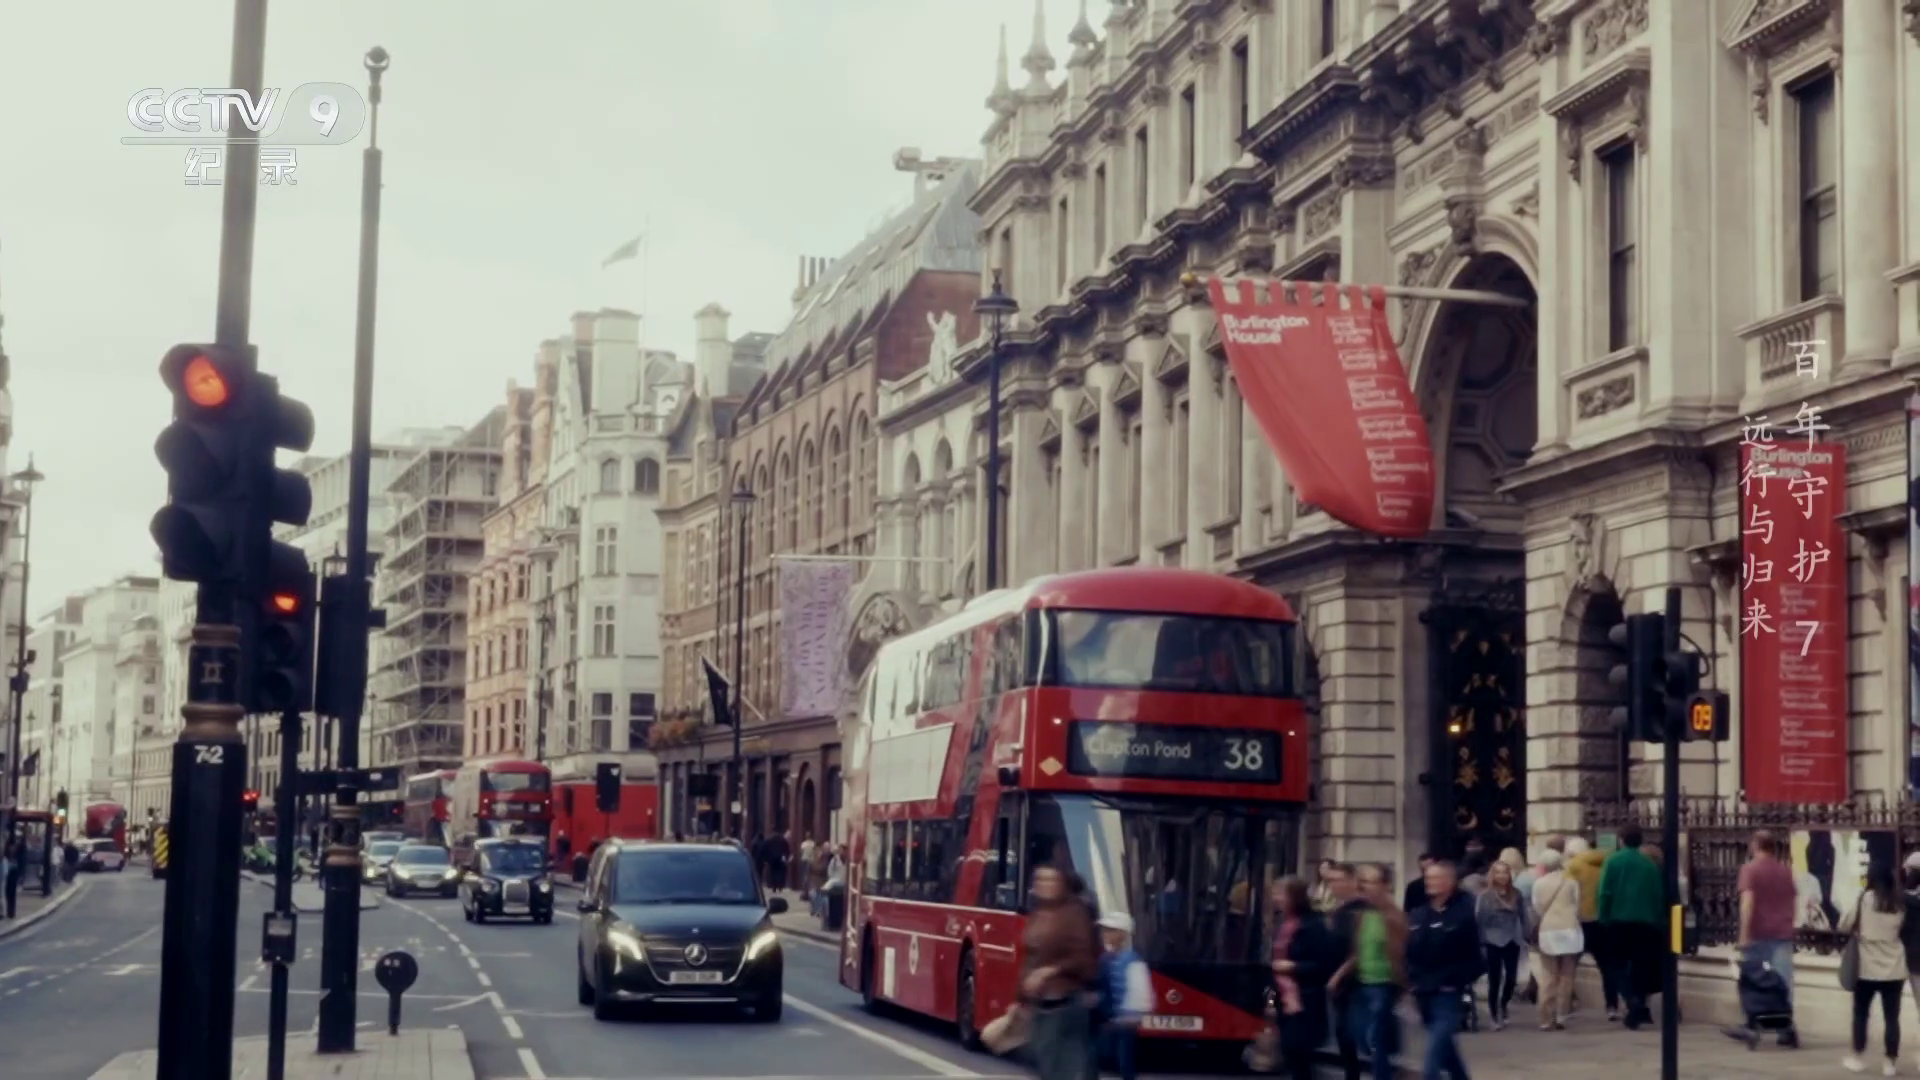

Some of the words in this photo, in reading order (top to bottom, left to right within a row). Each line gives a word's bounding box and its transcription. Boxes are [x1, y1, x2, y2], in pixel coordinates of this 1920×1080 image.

[1222, 313, 1309, 332] Burlington
[1227, 329, 1282, 344] House
[1750, 447, 1833, 466] Burlington
[194, 745, 225, 764] 72
[1154, 738, 1192, 759] Pond
[1223, 738, 1263, 771] 38
